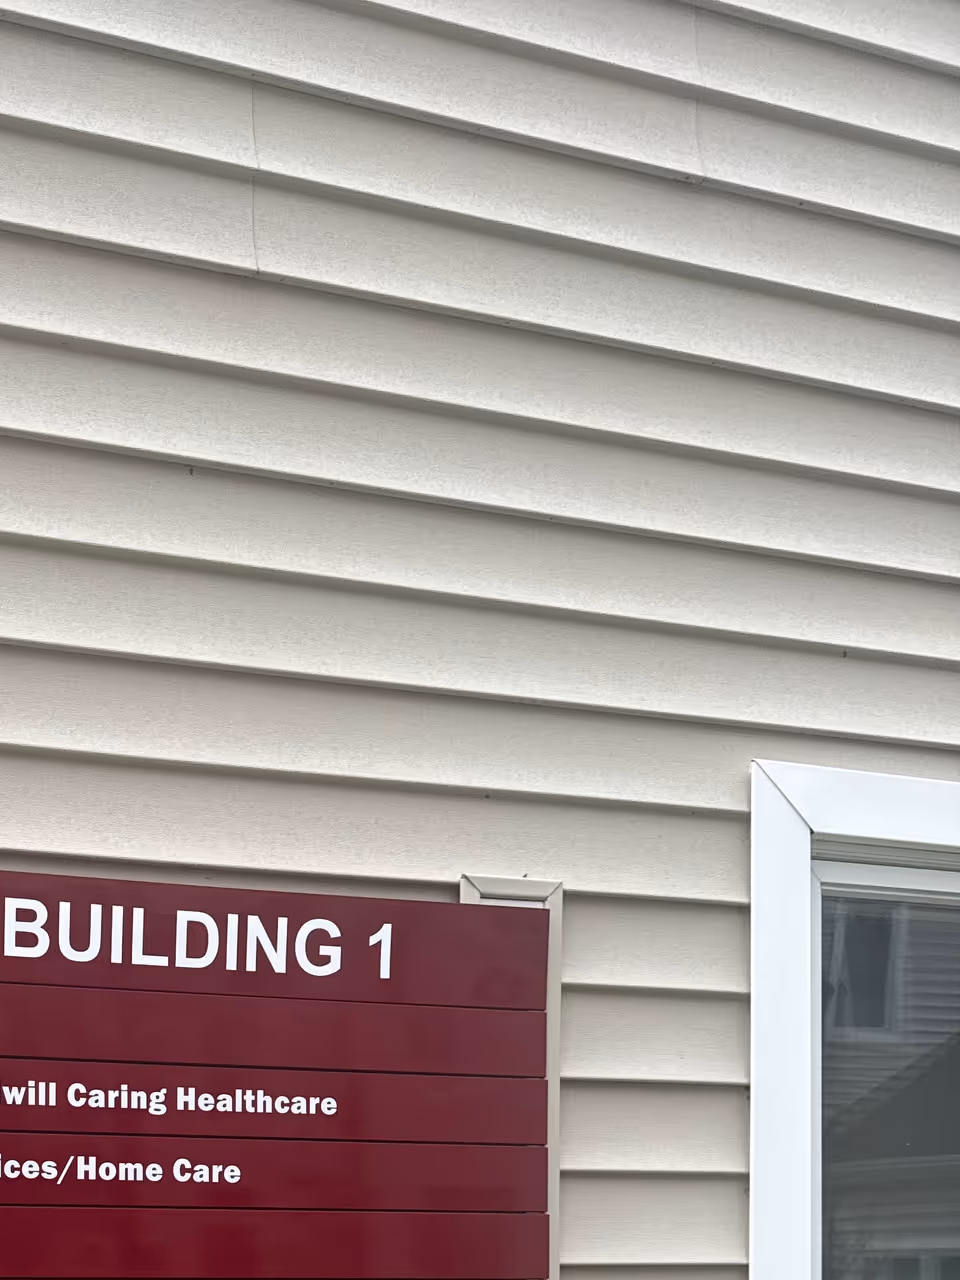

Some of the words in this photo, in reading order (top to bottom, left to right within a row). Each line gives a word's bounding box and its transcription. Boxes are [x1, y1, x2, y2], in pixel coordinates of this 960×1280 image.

[3, 896, 342, 977] BUILDING
[368, 923, 393, 980] 1
[67, 1082, 167, 1116] Caring
[176, 1086, 338, 1116] Healthcare
[172, 1158, 241, 1184] Care
